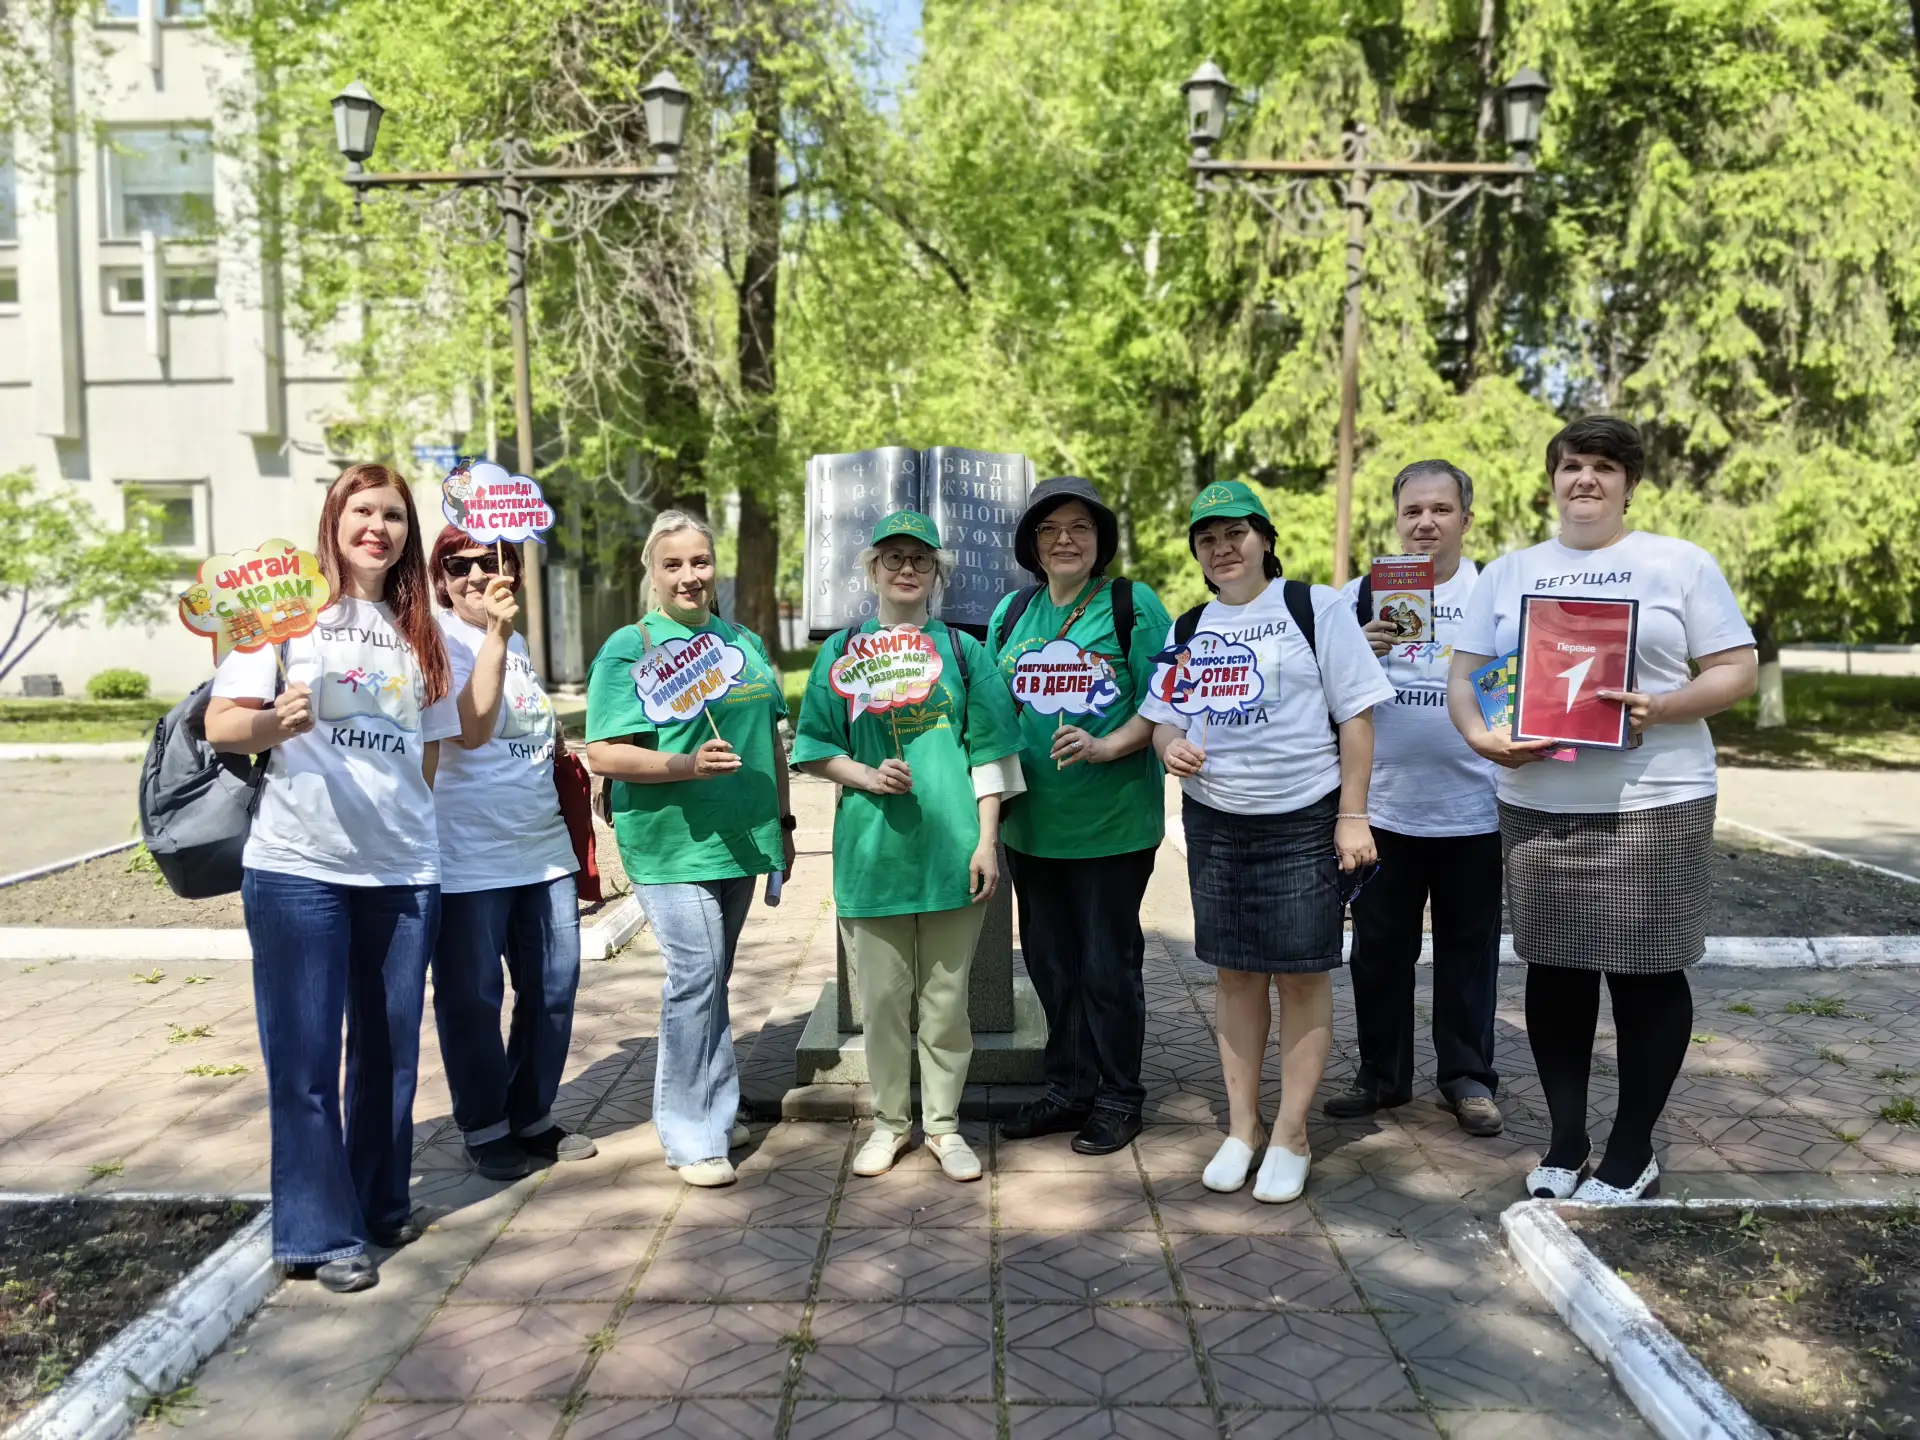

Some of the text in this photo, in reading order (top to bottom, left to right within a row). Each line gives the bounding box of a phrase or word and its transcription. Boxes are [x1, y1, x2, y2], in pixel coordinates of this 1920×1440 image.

[489, 482, 532, 496] ВПЕРЁД!
[463, 498, 545, 511] БИБЛИОТЕКАРЬ
[465, 511, 549, 529] НА СТАРТЕ!
[1534, 571, 1632, 591] БЕГУЩАЯ
[1557, 642, 1596, 654] Первые
[655, 633, 714, 683] НА СТАРТ!
[1190, 654, 1252, 667] ВОПРОС ЕСТЬ?
[651, 646, 723, 707] ВНИМАНИЕ!
[1201, 666, 1249, 684] ОТВЕТ
[670, 666, 727, 714] ЧИТАЙ!
[1016, 675, 1093, 696] Я В ДЕЛЕ!
[1201, 684, 1250, 697] В КНИГЕ!
[1206, 708, 1269, 726] КНИГА
[331, 727, 406, 755] КНИГА
